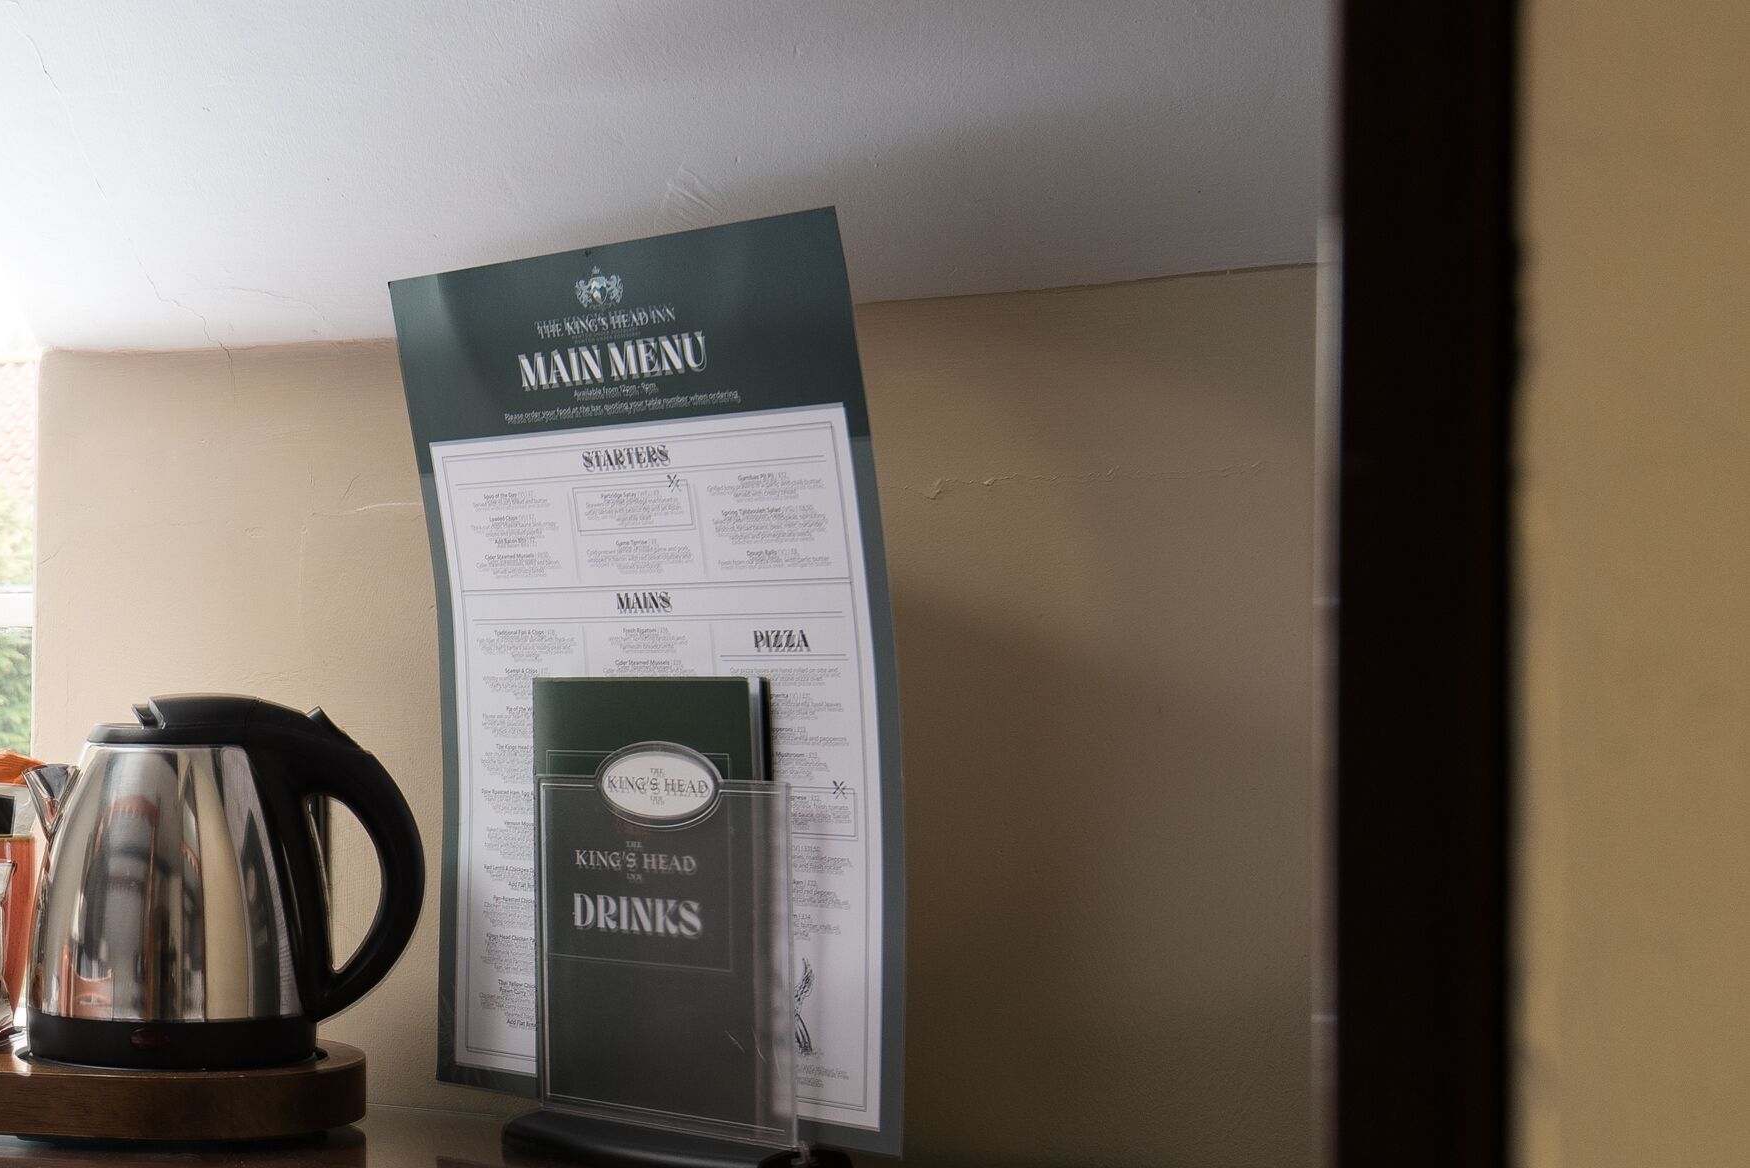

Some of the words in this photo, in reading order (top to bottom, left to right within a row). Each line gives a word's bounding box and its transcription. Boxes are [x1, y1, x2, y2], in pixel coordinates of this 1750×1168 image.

[534, 318, 562, 339] THE
[563, 313, 608, 334] KING'S
[610, 308, 650, 330] HEAD
[650, 303, 676, 323] INN
[518, 345, 604, 391] MAIN
[607, 331, 707, 380] MENU
[582, 444, 670, 470] STARTERS
[616, 591, 671, 612] MAINS
[753, 629, 810, 650] PIZZA
[650, 767, 665, 777] THE
[607, 775, 659, 794] KING'S
[664, 778, 710, 798] HEAD
[625, 840, 643, 849] THE
[574, 849, 637, 870] KING'S
[642, 853, 697, 875] HEAD
[626, 873, 643, 882] INN
[573, 892, 703, 938] DRINKS
